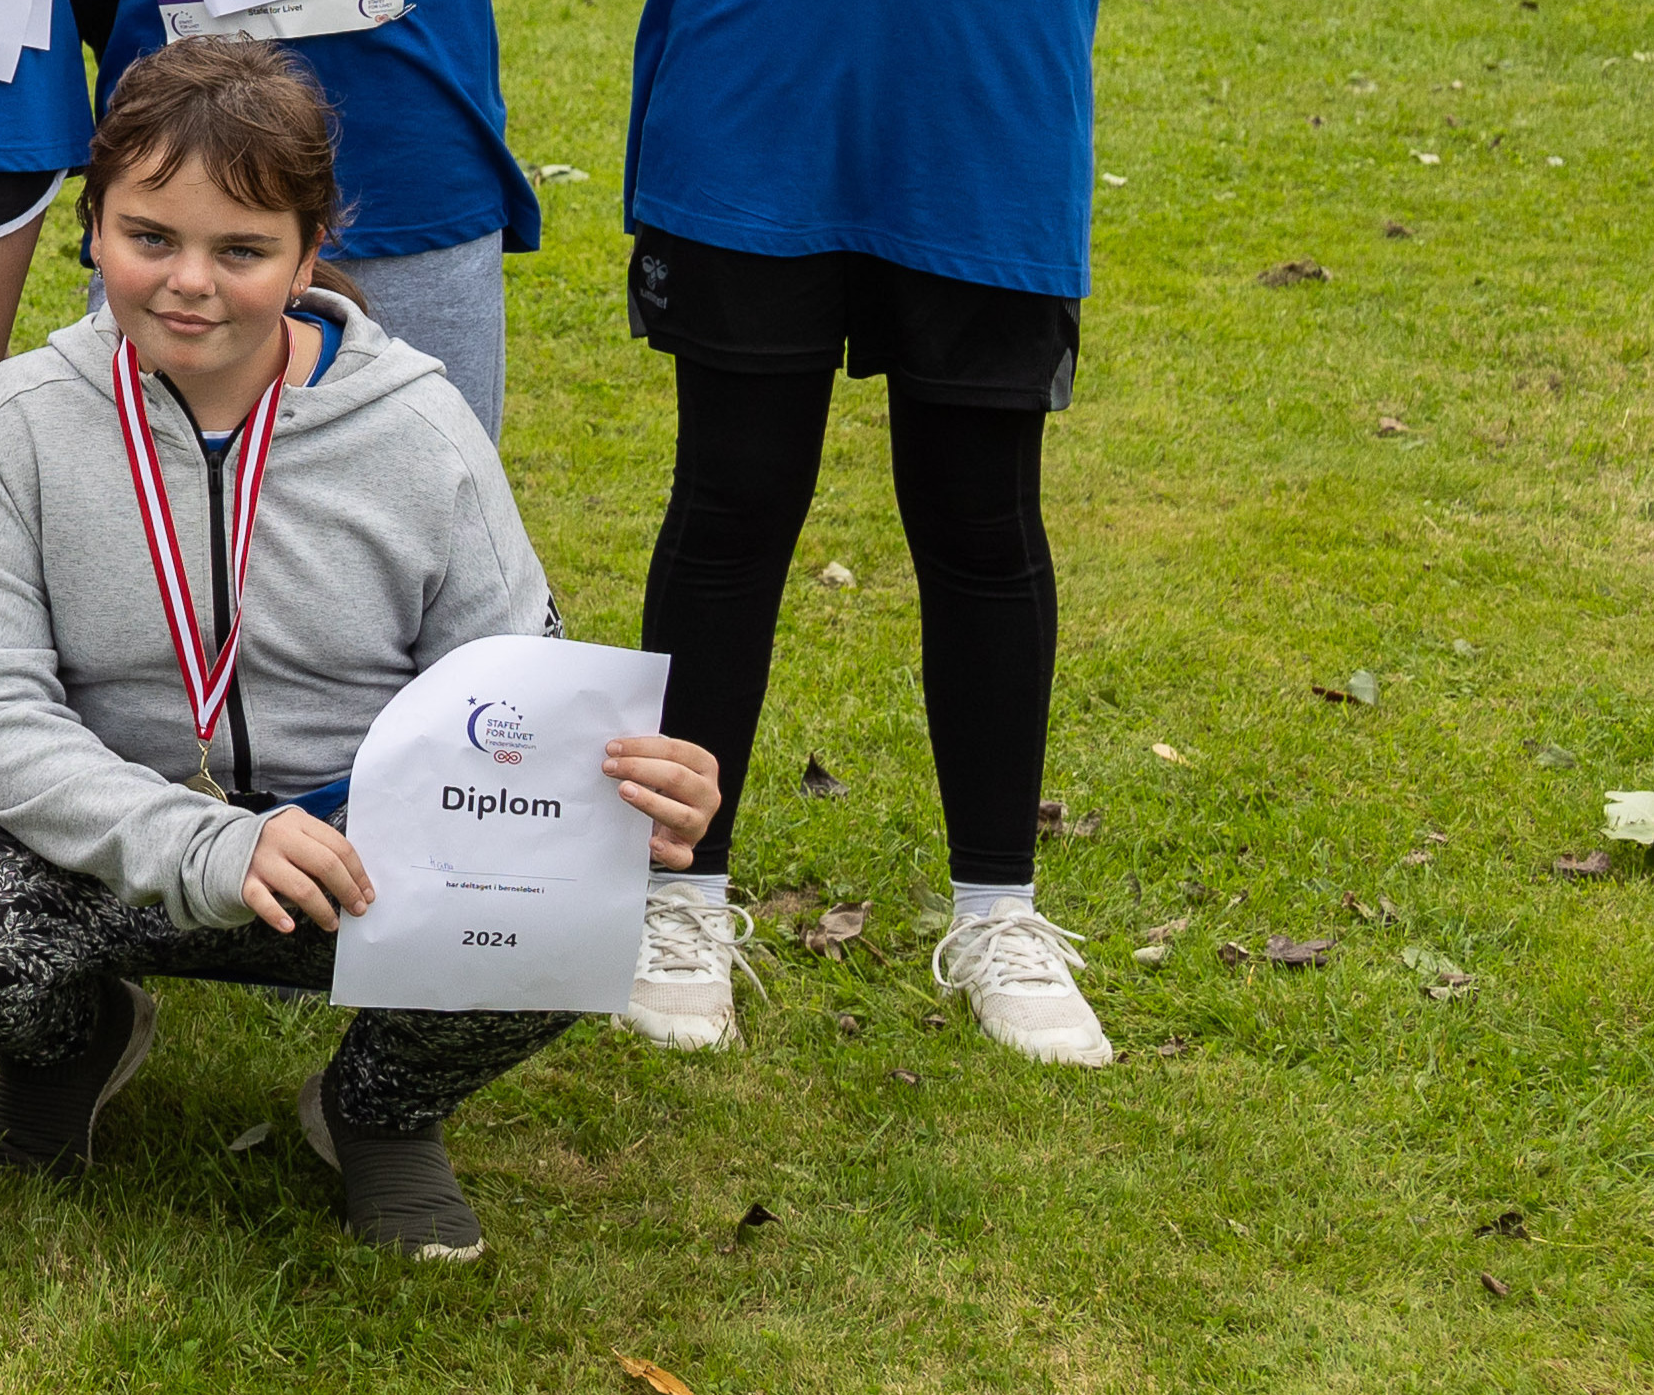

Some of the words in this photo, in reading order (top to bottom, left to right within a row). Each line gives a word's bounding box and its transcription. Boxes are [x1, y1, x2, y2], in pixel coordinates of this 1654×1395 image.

[270, 6, 280, 14] for
[282, 4, 303, 13] Livet
[487, 718, 520, 730] STAFET
[485, 728, 505, 738] FOR
[507, 732, 534, 741] LIVET
[442, 785, 561, 820] Diplom
[446, 880, 459, 888] har
[460, 881, 492, 891] deltaget
[462, 930, 518, 947] 2024
